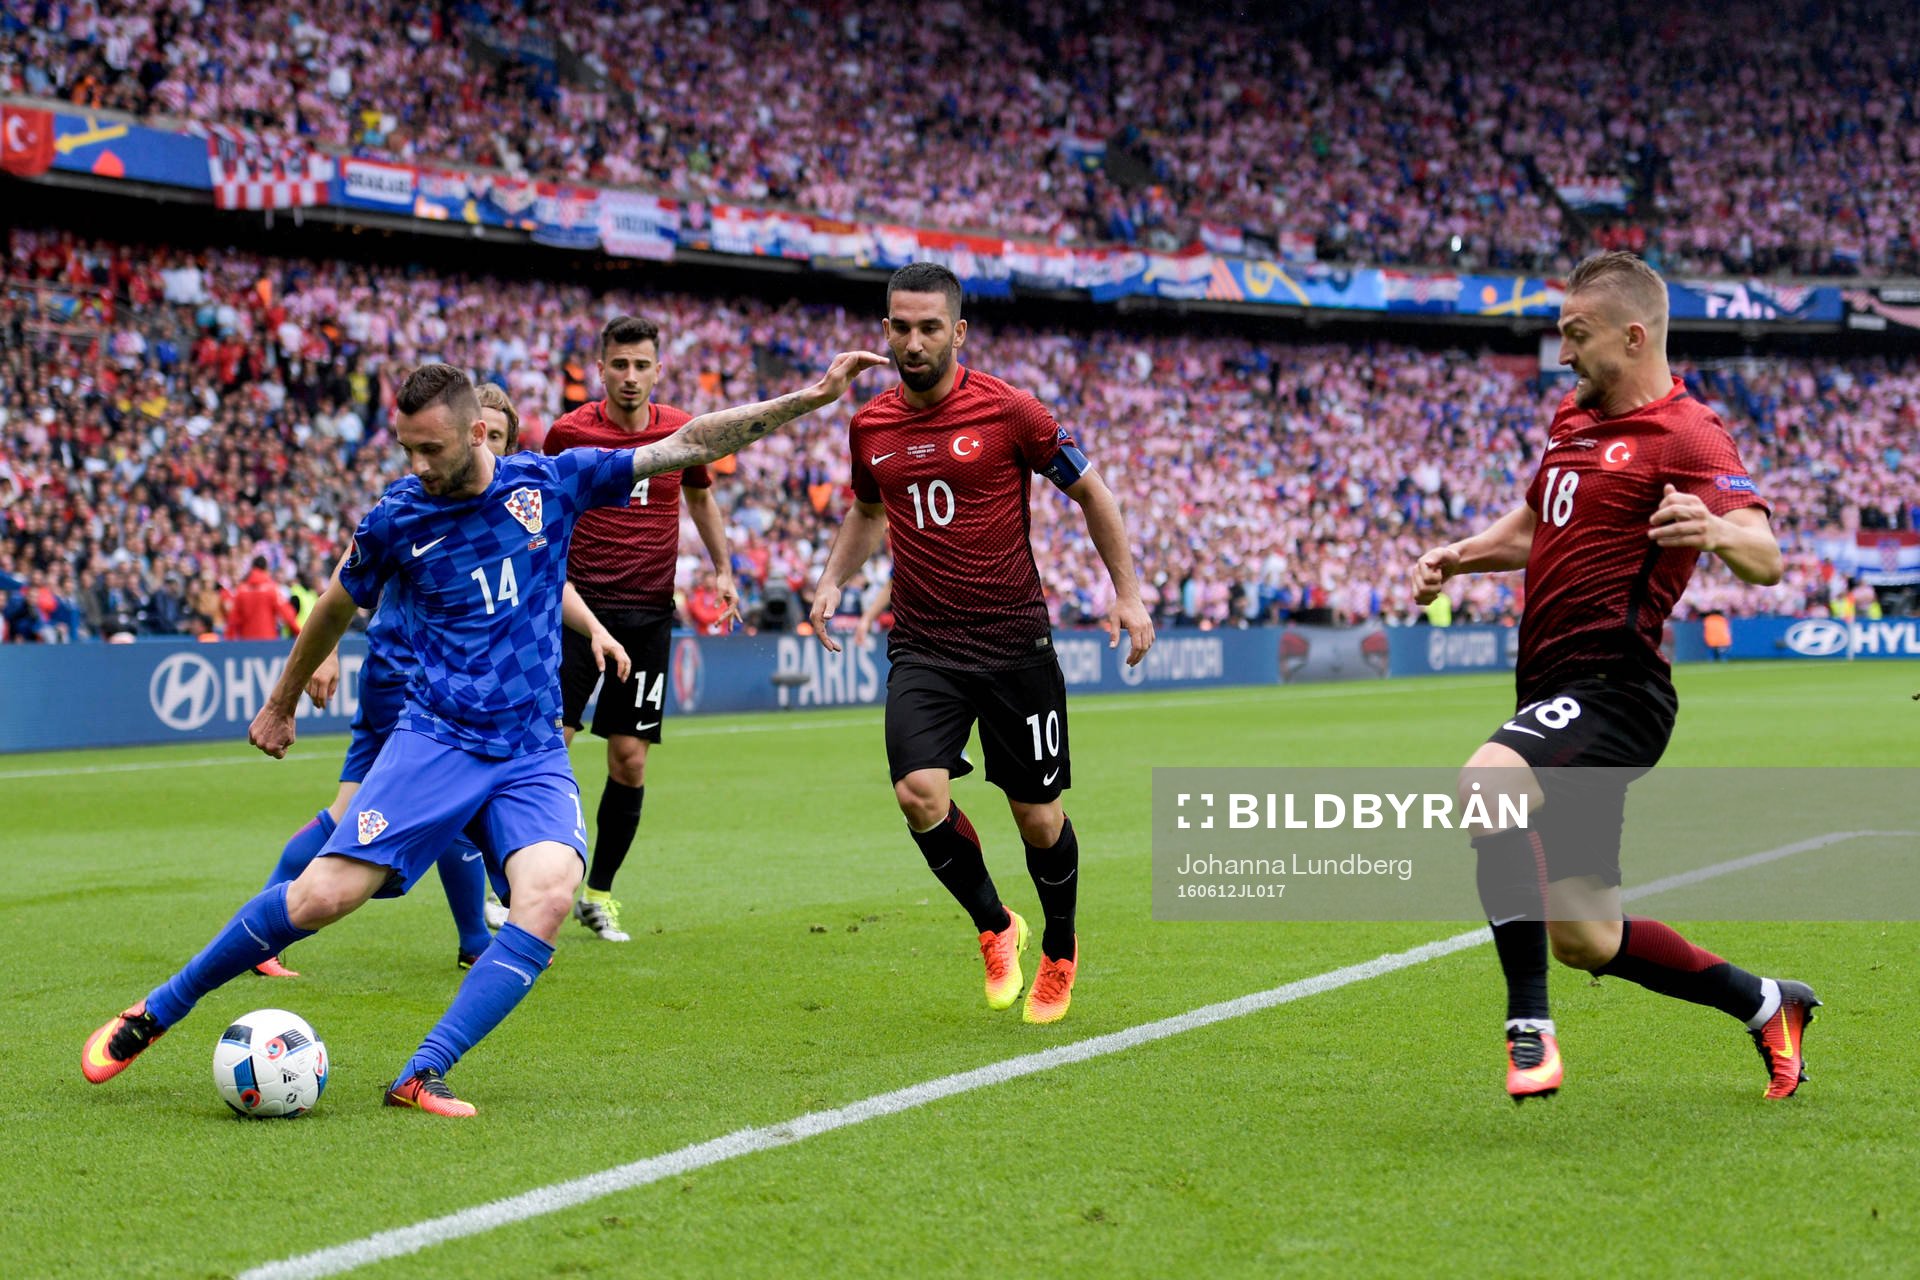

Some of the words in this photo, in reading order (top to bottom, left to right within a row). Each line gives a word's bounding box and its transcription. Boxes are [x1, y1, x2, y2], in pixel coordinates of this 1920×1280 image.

[907, 479, 955, 529] 10
[1542, 467, 1580, 527] 18
[470, 557, 519, 615] 14
[634, 671, 665, 711] 14
[777, 635, 878, 706] PARIS
[1026, 709, 1060, 761] 10
